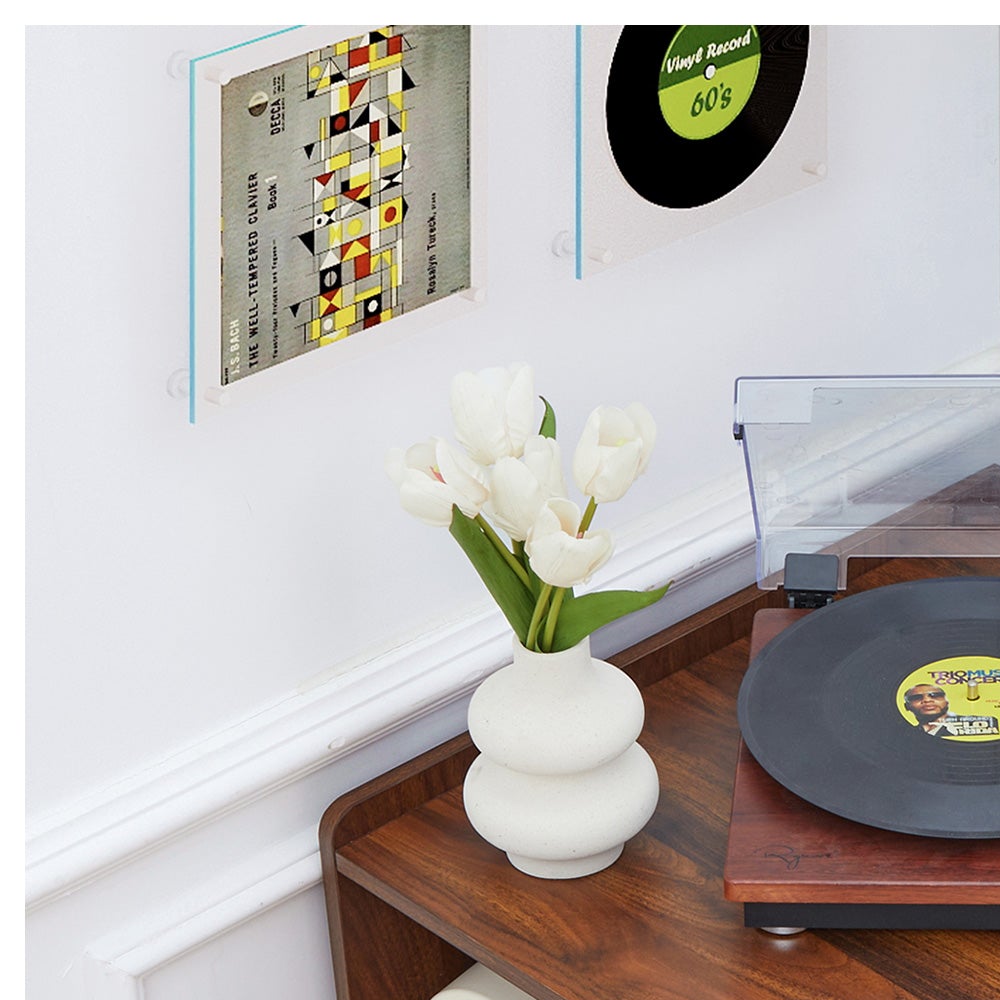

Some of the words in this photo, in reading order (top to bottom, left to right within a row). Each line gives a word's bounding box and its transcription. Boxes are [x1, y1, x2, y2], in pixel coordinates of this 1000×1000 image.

[666, 47, 703, 74] Vinyl
[706, 28, 752, 60] Record
[270, 98, 281, 136] DECCA
[690, 82, 733, 118] 60's
[248, 172, 259, 226] CLAVIER
[267, 183, 277, 211] Book
[248, 230, 259, 339] WELL-TEMPERED
[427, 253, 438, 296] Rosalyn
[248, 343, 259, 368] THE
